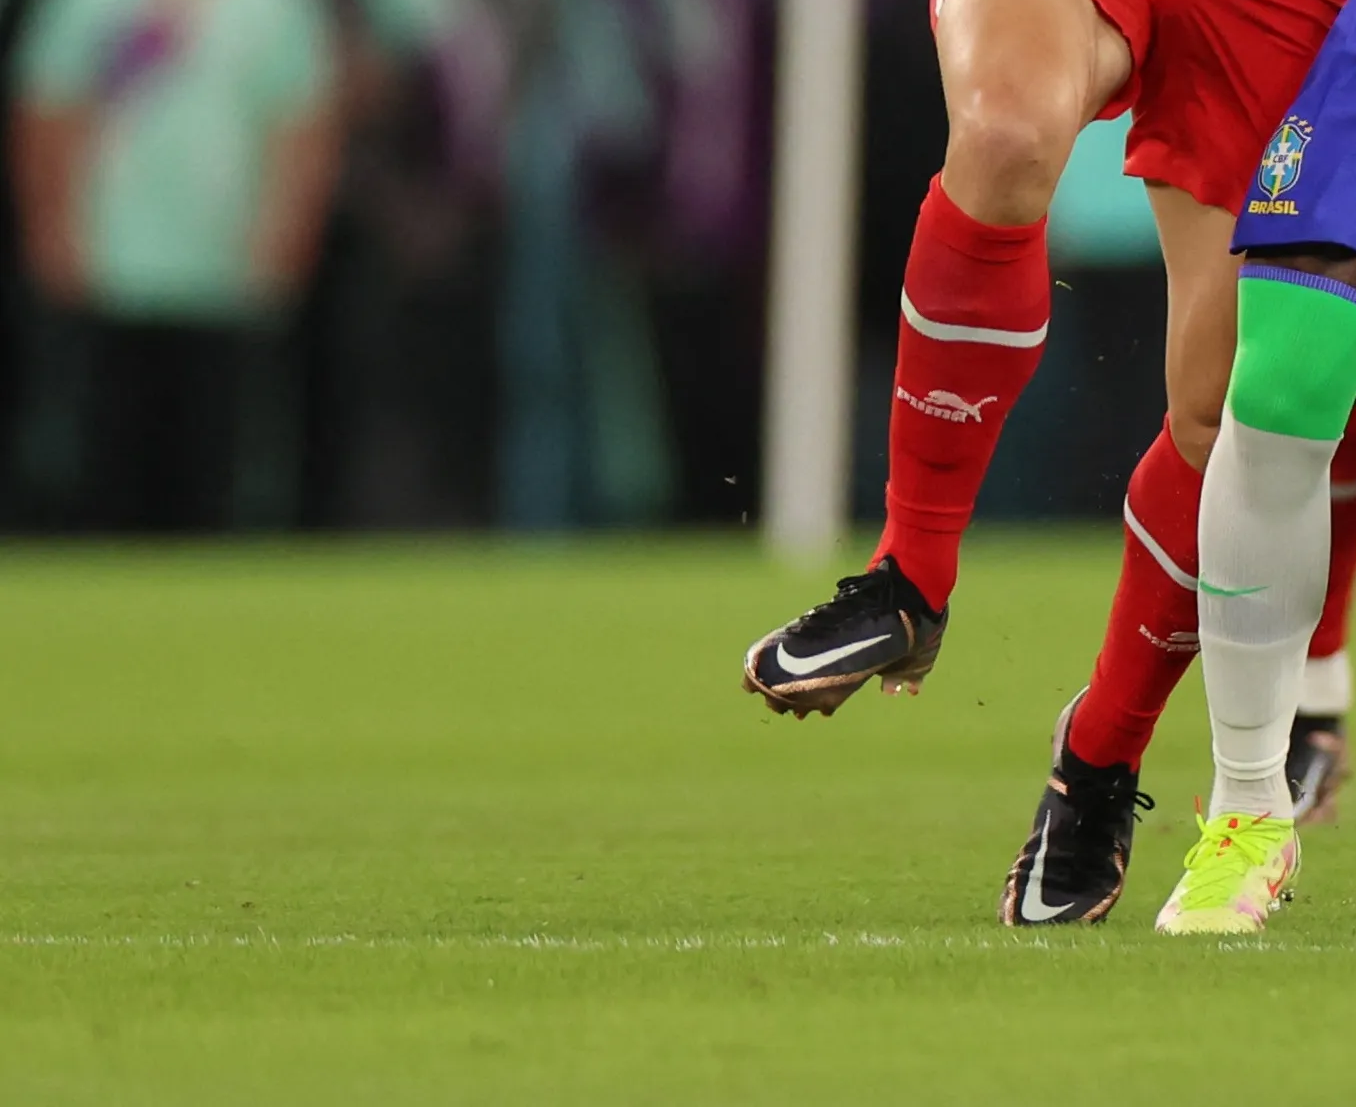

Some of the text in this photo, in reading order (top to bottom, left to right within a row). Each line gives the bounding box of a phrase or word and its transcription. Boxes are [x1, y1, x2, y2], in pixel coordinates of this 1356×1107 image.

[1272, 154, 1289, 164] CBF
[1247, 199, 1300, 216] BRASIL
[896, 386, 968, 423] PUMA
